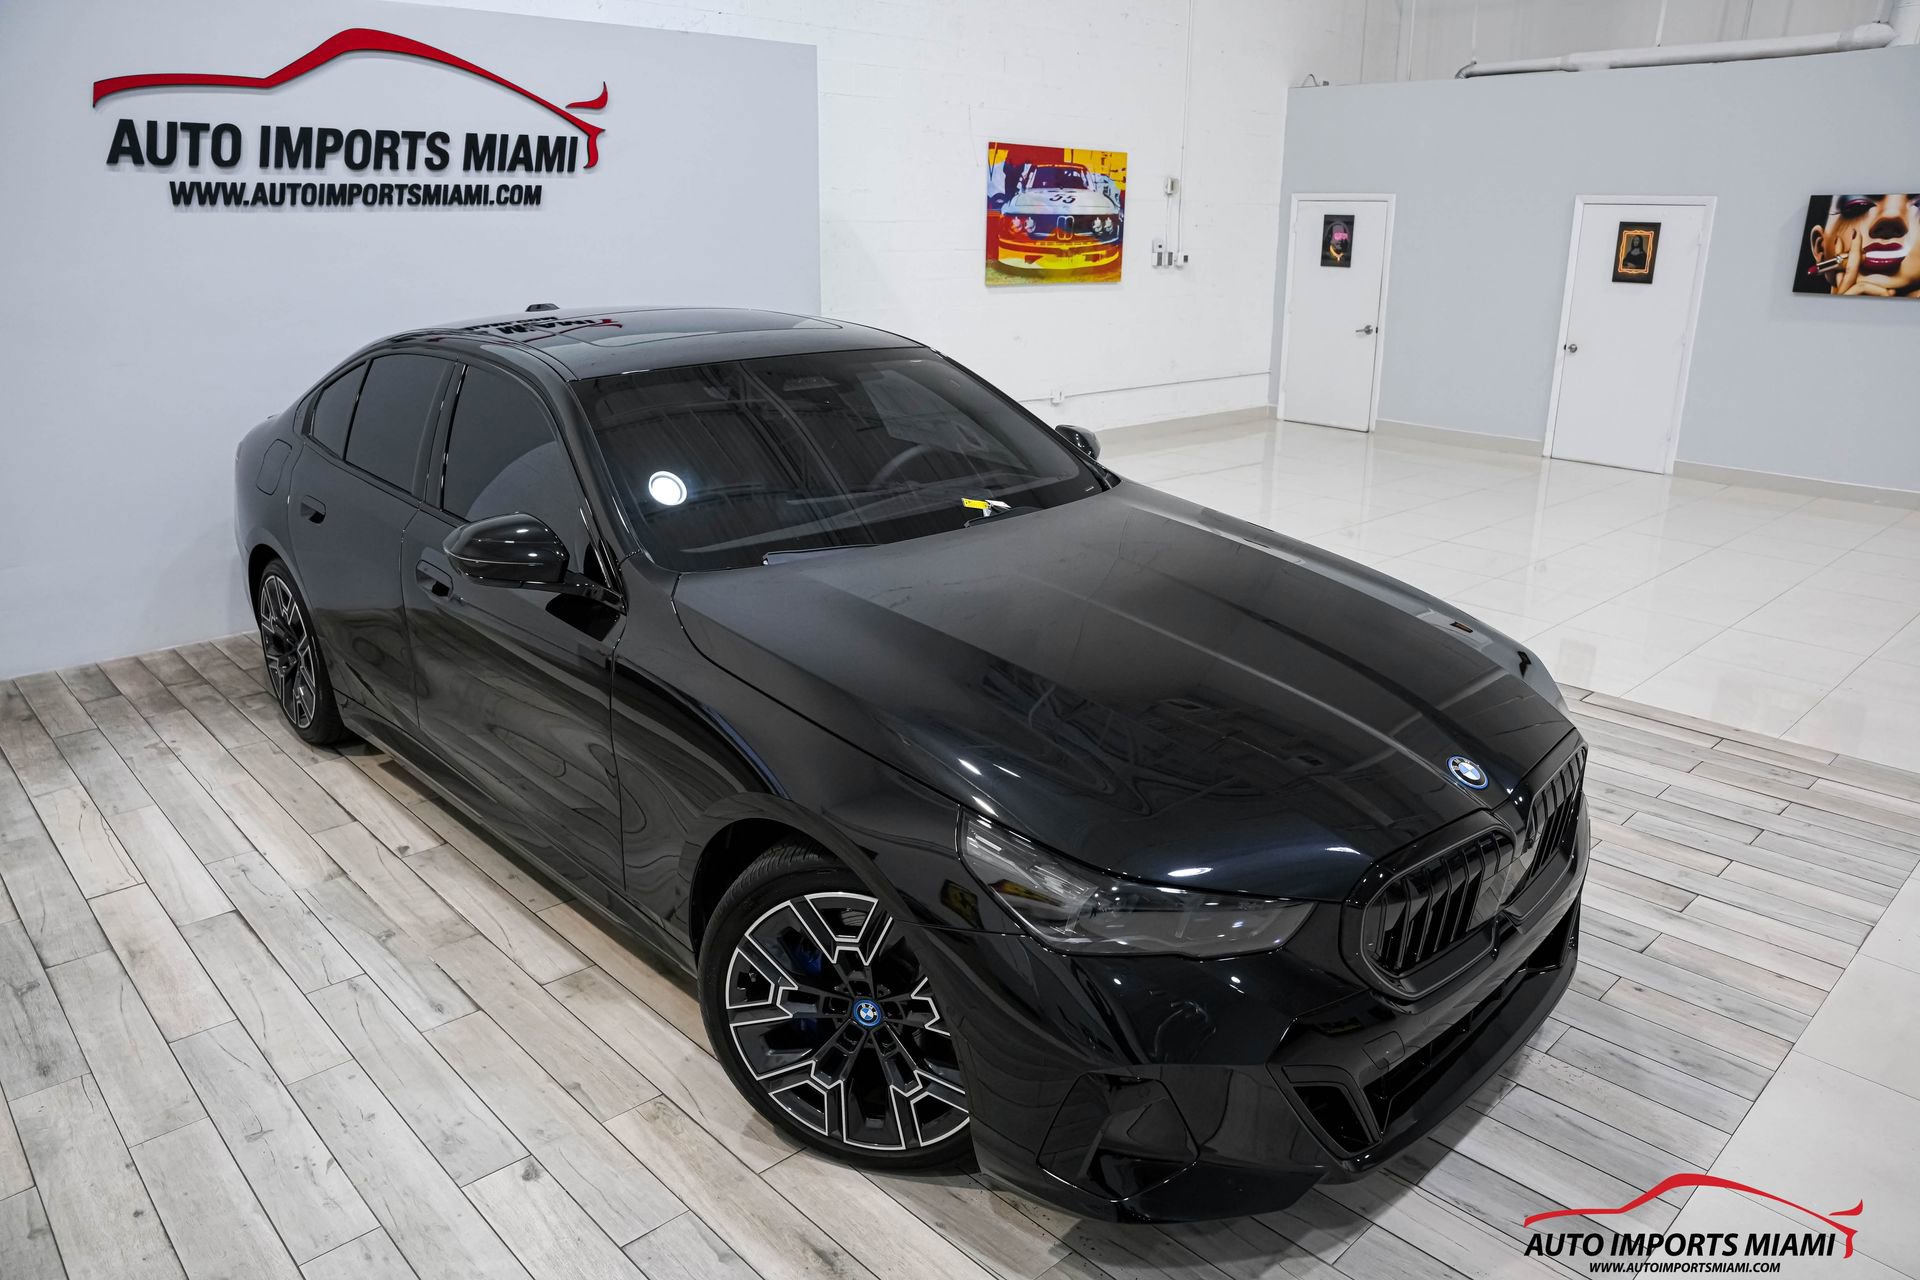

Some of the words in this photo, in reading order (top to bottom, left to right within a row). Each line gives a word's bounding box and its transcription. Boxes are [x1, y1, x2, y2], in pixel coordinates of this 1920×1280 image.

[106, 118, 242, 169] AUTO
[259, 125, 450, 172] IMPORTS
[462, 132, 579, 173] MIAMI
[169, 181, 542, 207] WWW.AUTOIMPORTSMIAMI.COM
